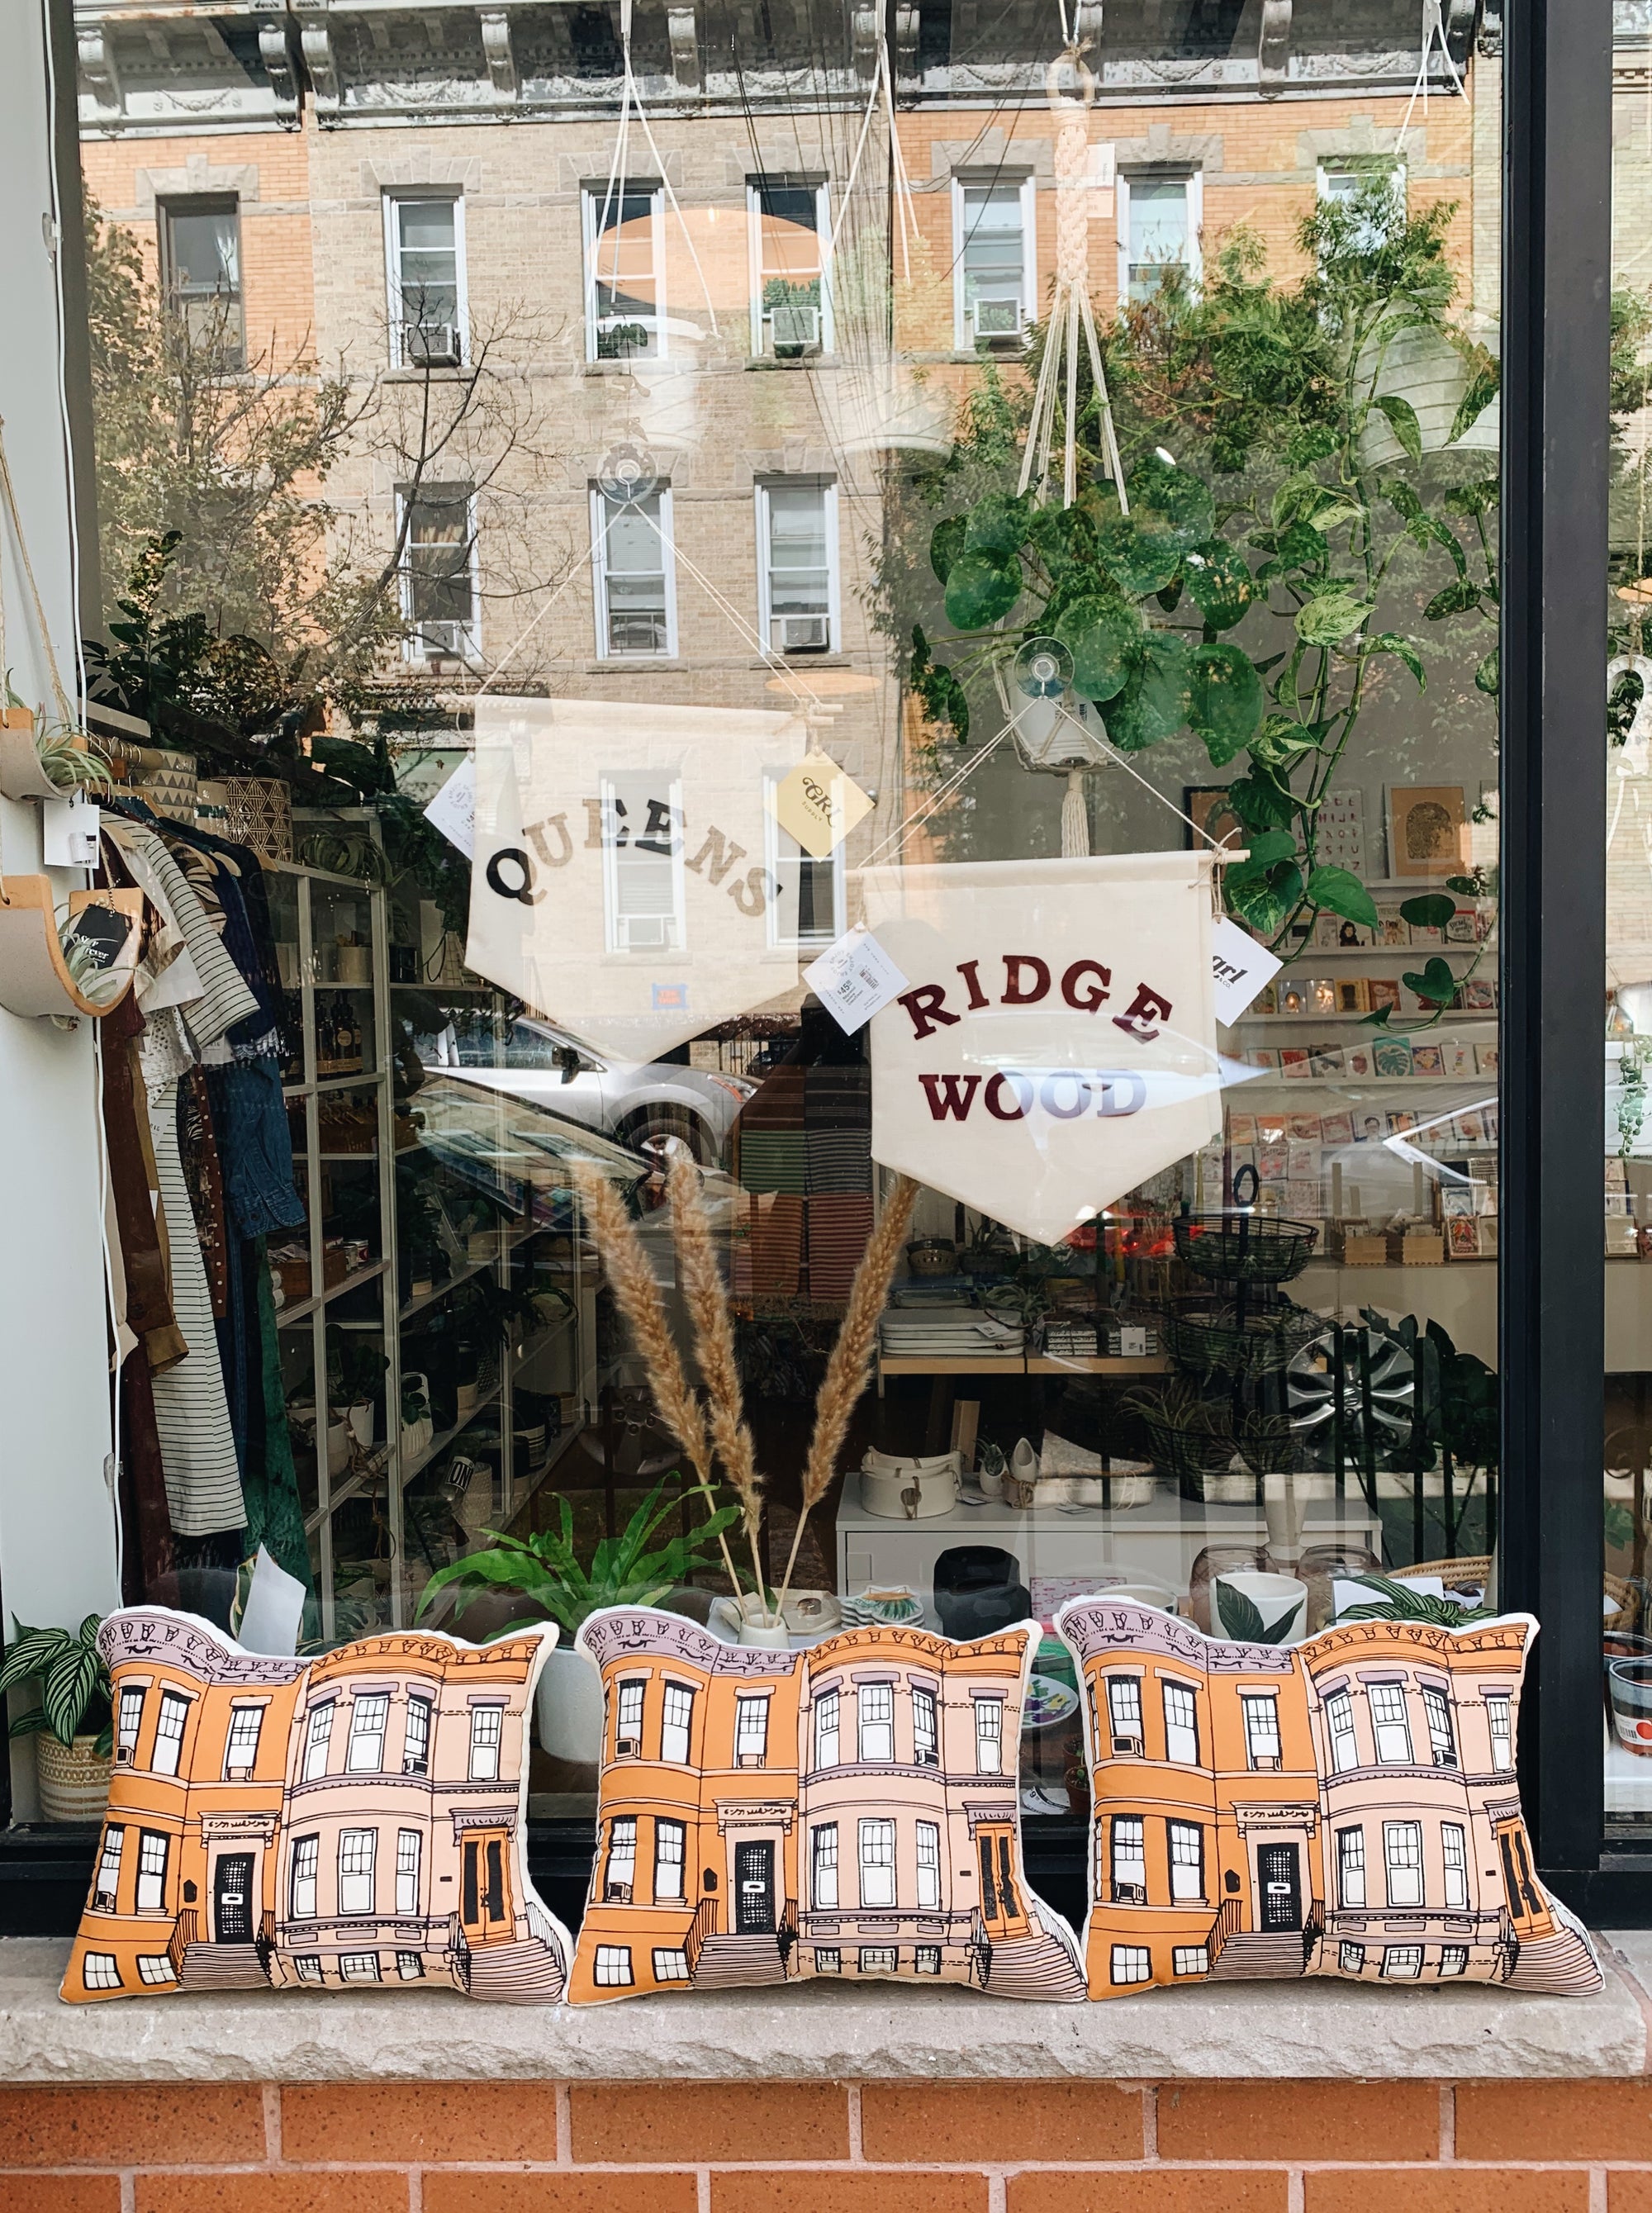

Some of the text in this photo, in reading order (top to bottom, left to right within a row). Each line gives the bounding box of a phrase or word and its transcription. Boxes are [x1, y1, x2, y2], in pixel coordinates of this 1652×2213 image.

[800, 800, 823, 822] SUPPLY
[486, 798, 784, 917] QUEENS
[896, 954, 1174, 1045] RIDGE
[918, 1067, 1147, 1122] WOOD
